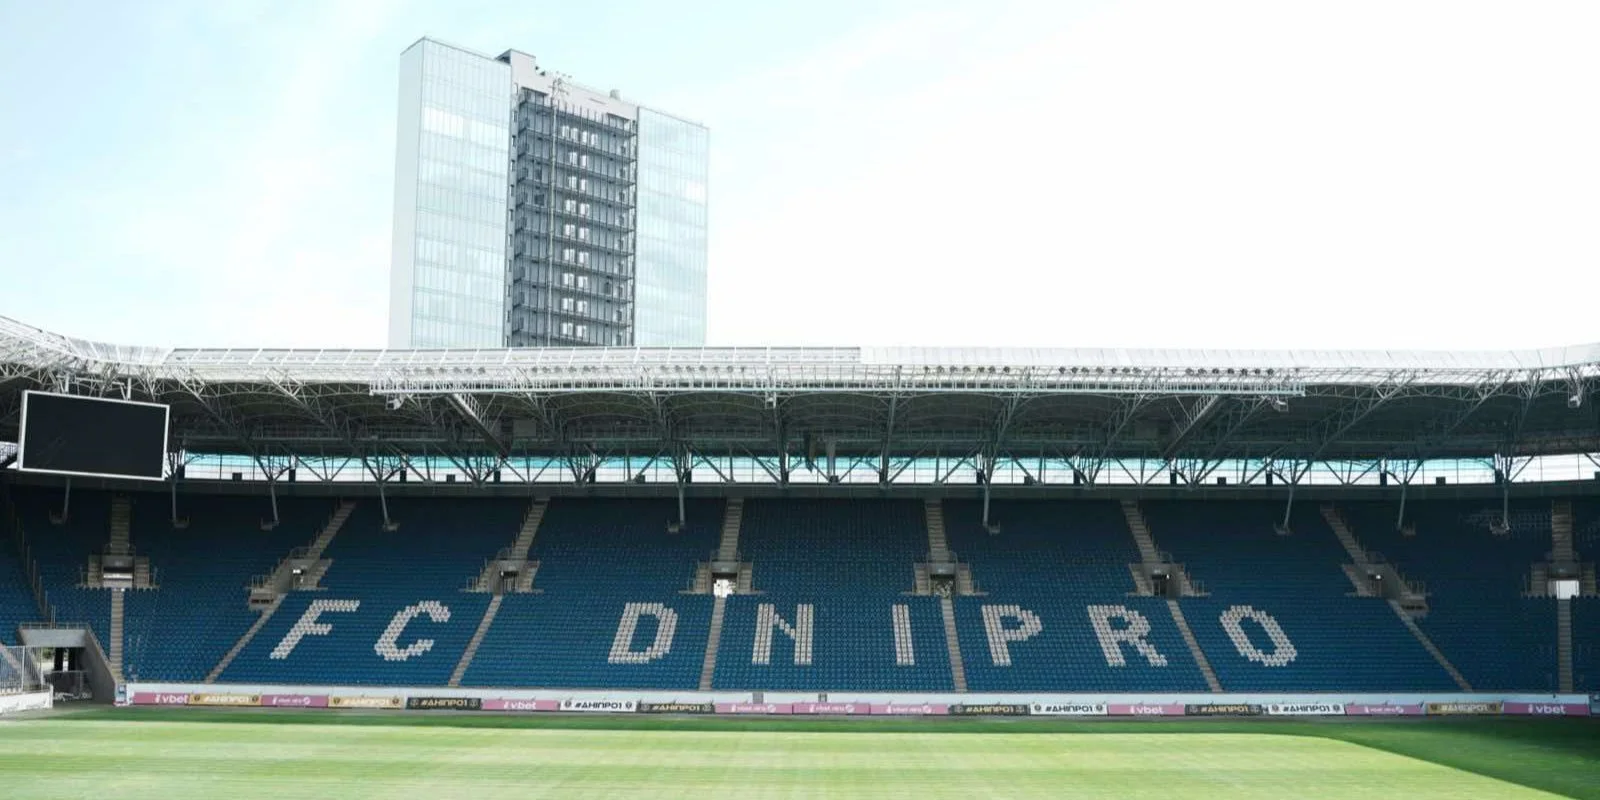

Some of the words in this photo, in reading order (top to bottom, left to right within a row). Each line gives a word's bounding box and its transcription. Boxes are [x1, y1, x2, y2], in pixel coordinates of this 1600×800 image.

[270, 600, 451, 662] FC
[608, 602, 1297, 668] DNIPRO
[1535, 704, 1567, 714] vbet
